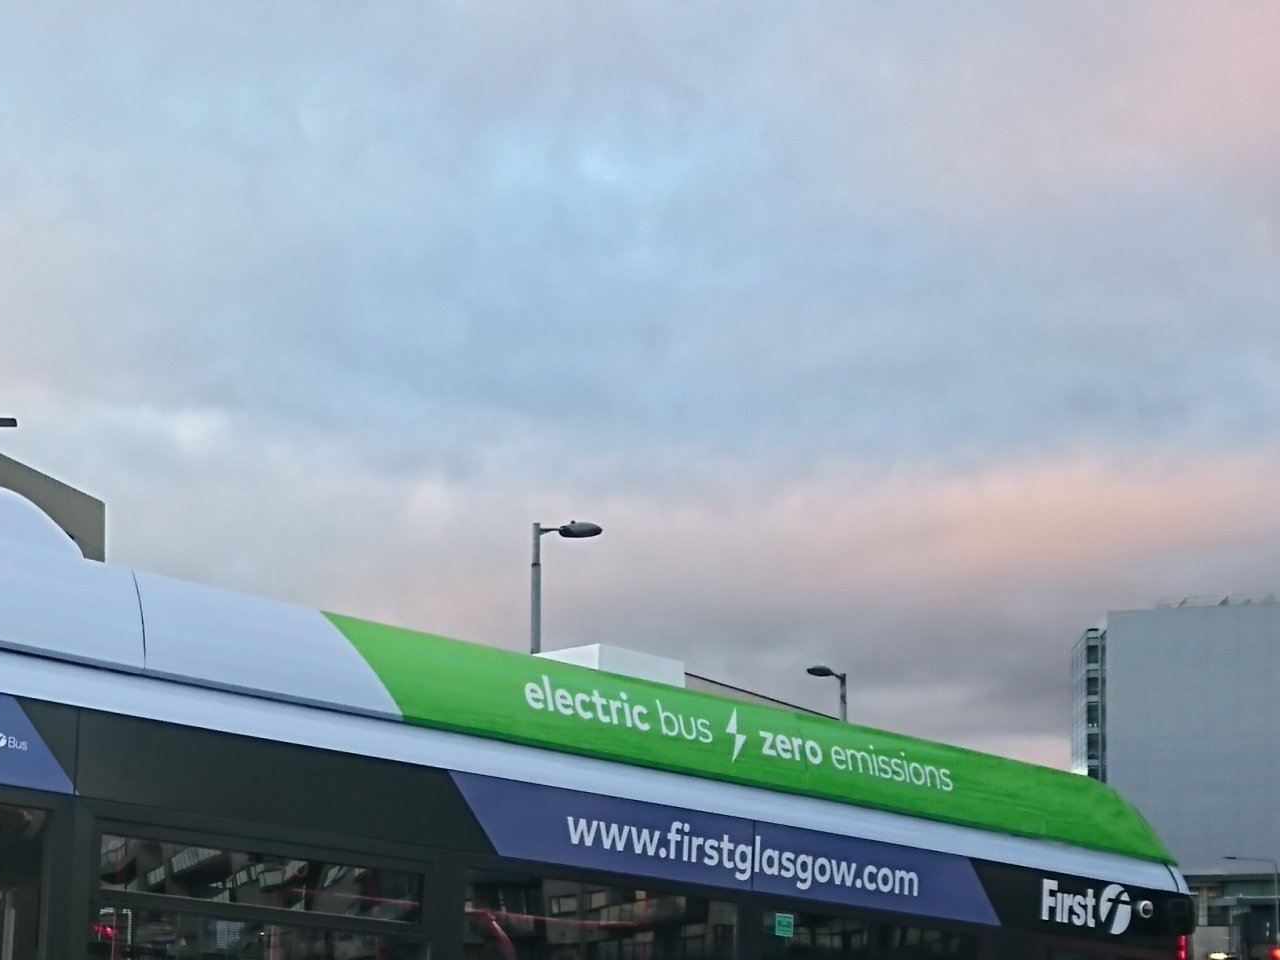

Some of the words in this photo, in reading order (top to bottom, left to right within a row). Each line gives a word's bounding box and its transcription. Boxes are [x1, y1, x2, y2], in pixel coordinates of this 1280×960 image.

[7, 736, 28, 751] Bus
[524, 675, 651, 732] electric
[657, 699, 713, 744] bus
[759, 728, 823, 766] zero
[830, 747, 954, 793] emissions
[566, 815, 919, 898] www.firstglasgow.com
[1040, 878, 1097, 929] First
